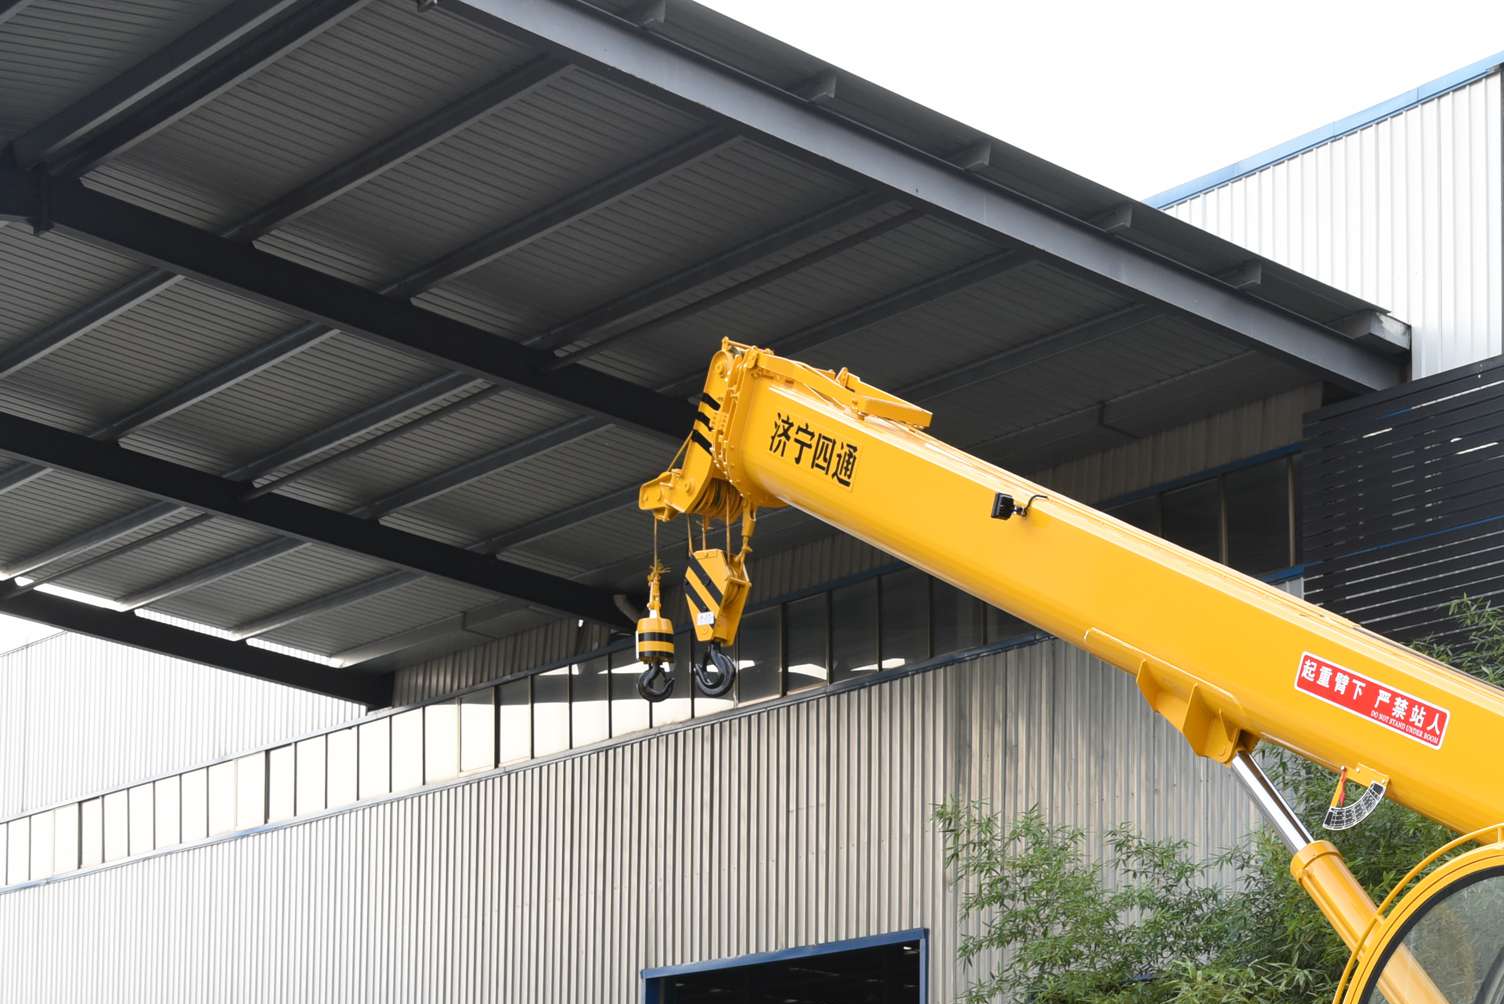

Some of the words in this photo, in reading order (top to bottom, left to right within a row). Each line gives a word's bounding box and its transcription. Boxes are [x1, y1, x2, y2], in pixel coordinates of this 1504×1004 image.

[769, 412, 858, 487] 济宁四通
[1301, 658, 1366, 701] 起重臂下
[1374, 689, 1441, 735] 严禁站人
